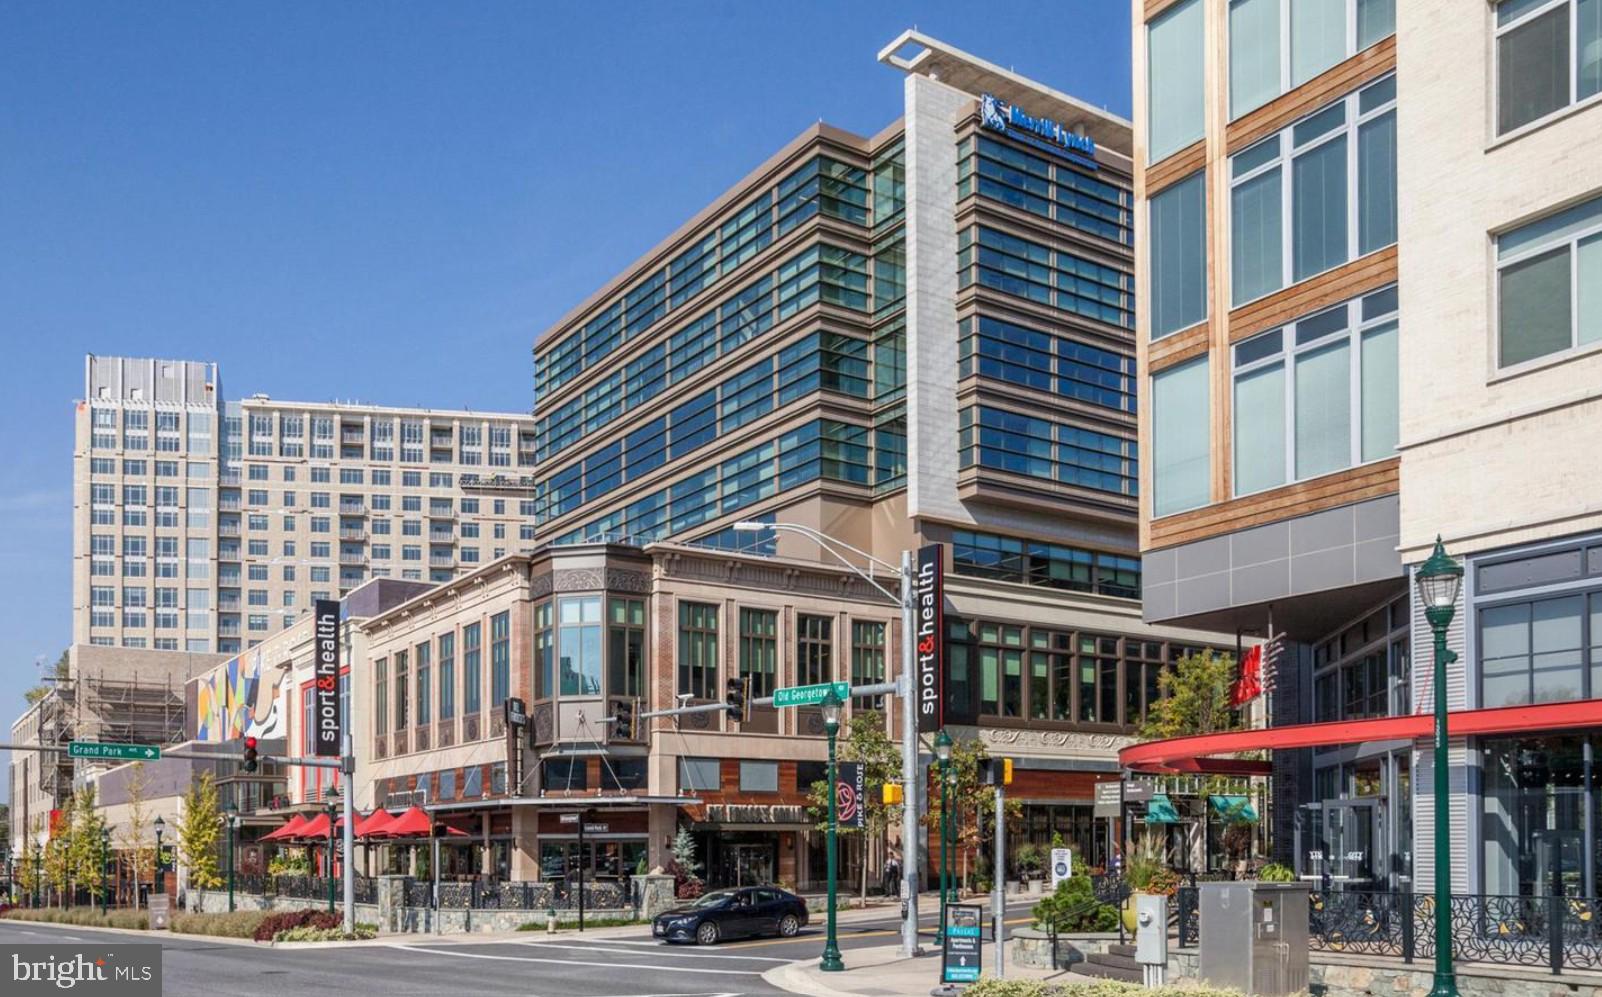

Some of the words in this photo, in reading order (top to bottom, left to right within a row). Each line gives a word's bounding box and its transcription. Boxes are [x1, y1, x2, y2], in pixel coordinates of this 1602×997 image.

[918, 562, 938, 714] sport&health
[317, 613, 339, 742] sport&health
[777, 691, 789, 702] Old
[73, 745, 99, 755] Grand
[102, 746, 122, 756] Park
[856, 763, 864, 791] ROSE
